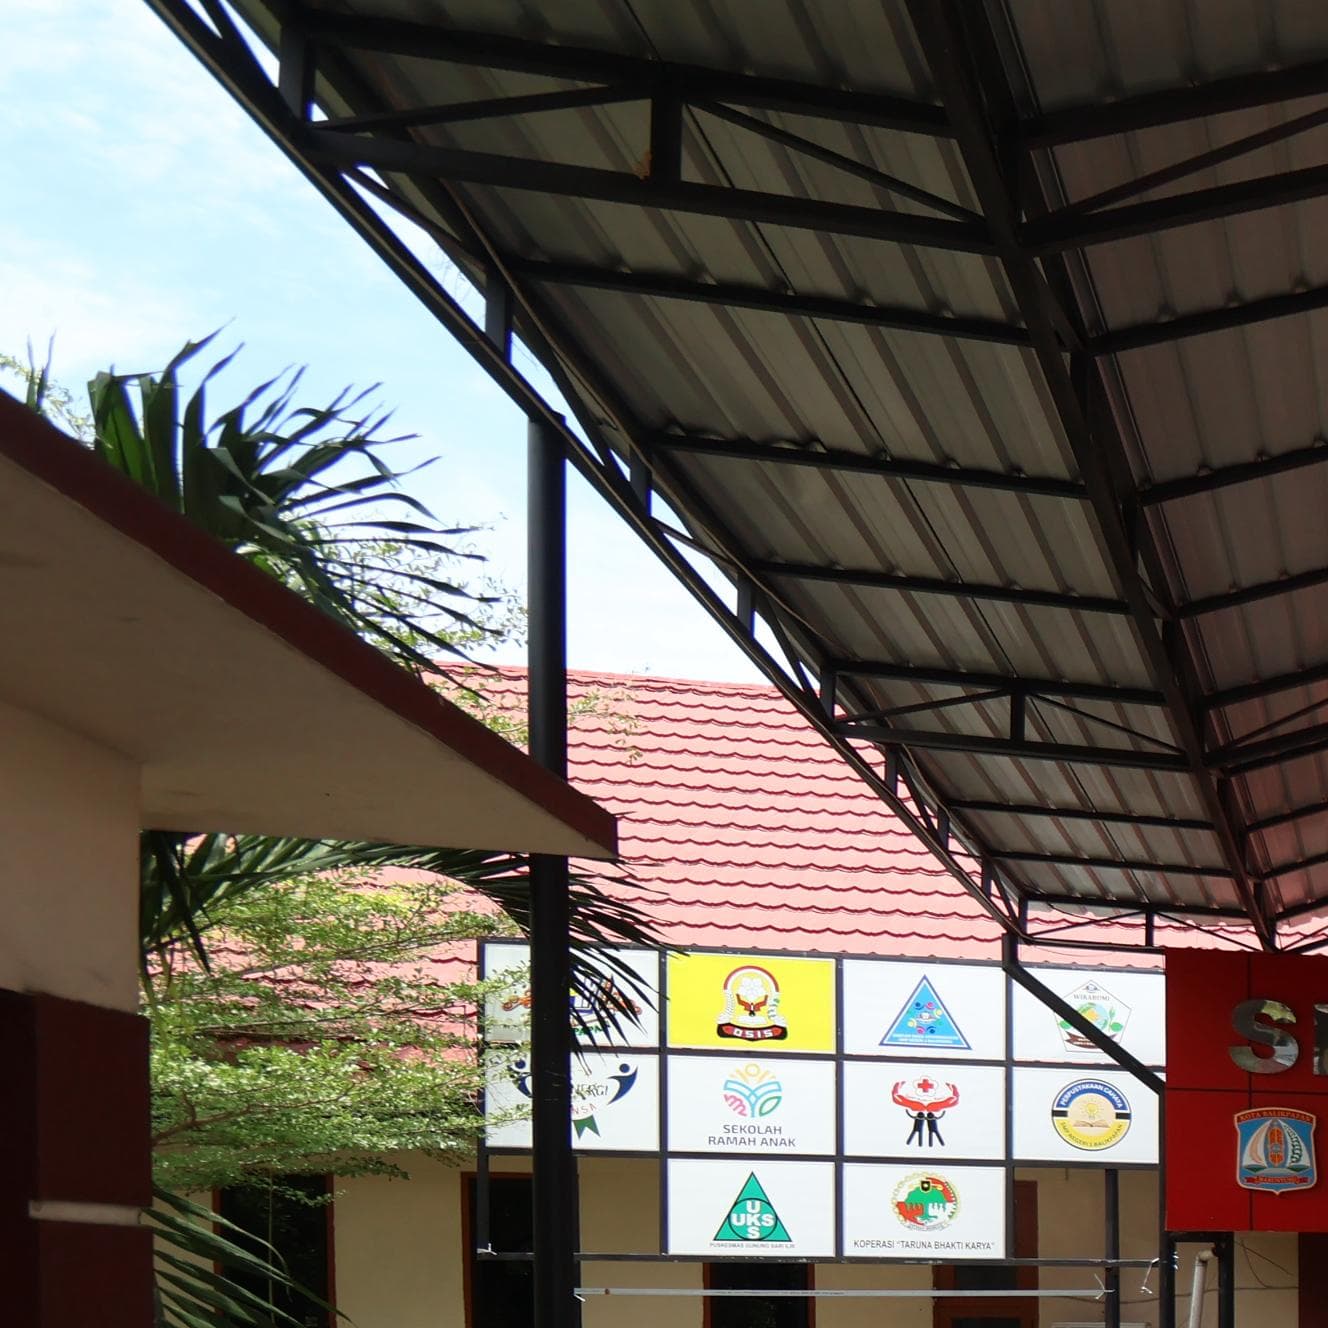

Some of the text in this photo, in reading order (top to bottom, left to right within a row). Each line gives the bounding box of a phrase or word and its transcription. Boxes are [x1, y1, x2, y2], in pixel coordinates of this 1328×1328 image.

[733, 1029, 773, 1038] OSIS
[723, 1125, 782, 1135] SEKOLAH
[708, 1136, 796, 1147] RAMAH ANAK
[730, 1213, 775, 1227] UKS
[854, 1240, 895, 1249] KOPERASI
[934, 1241, 963, 1250] BHAKTI
